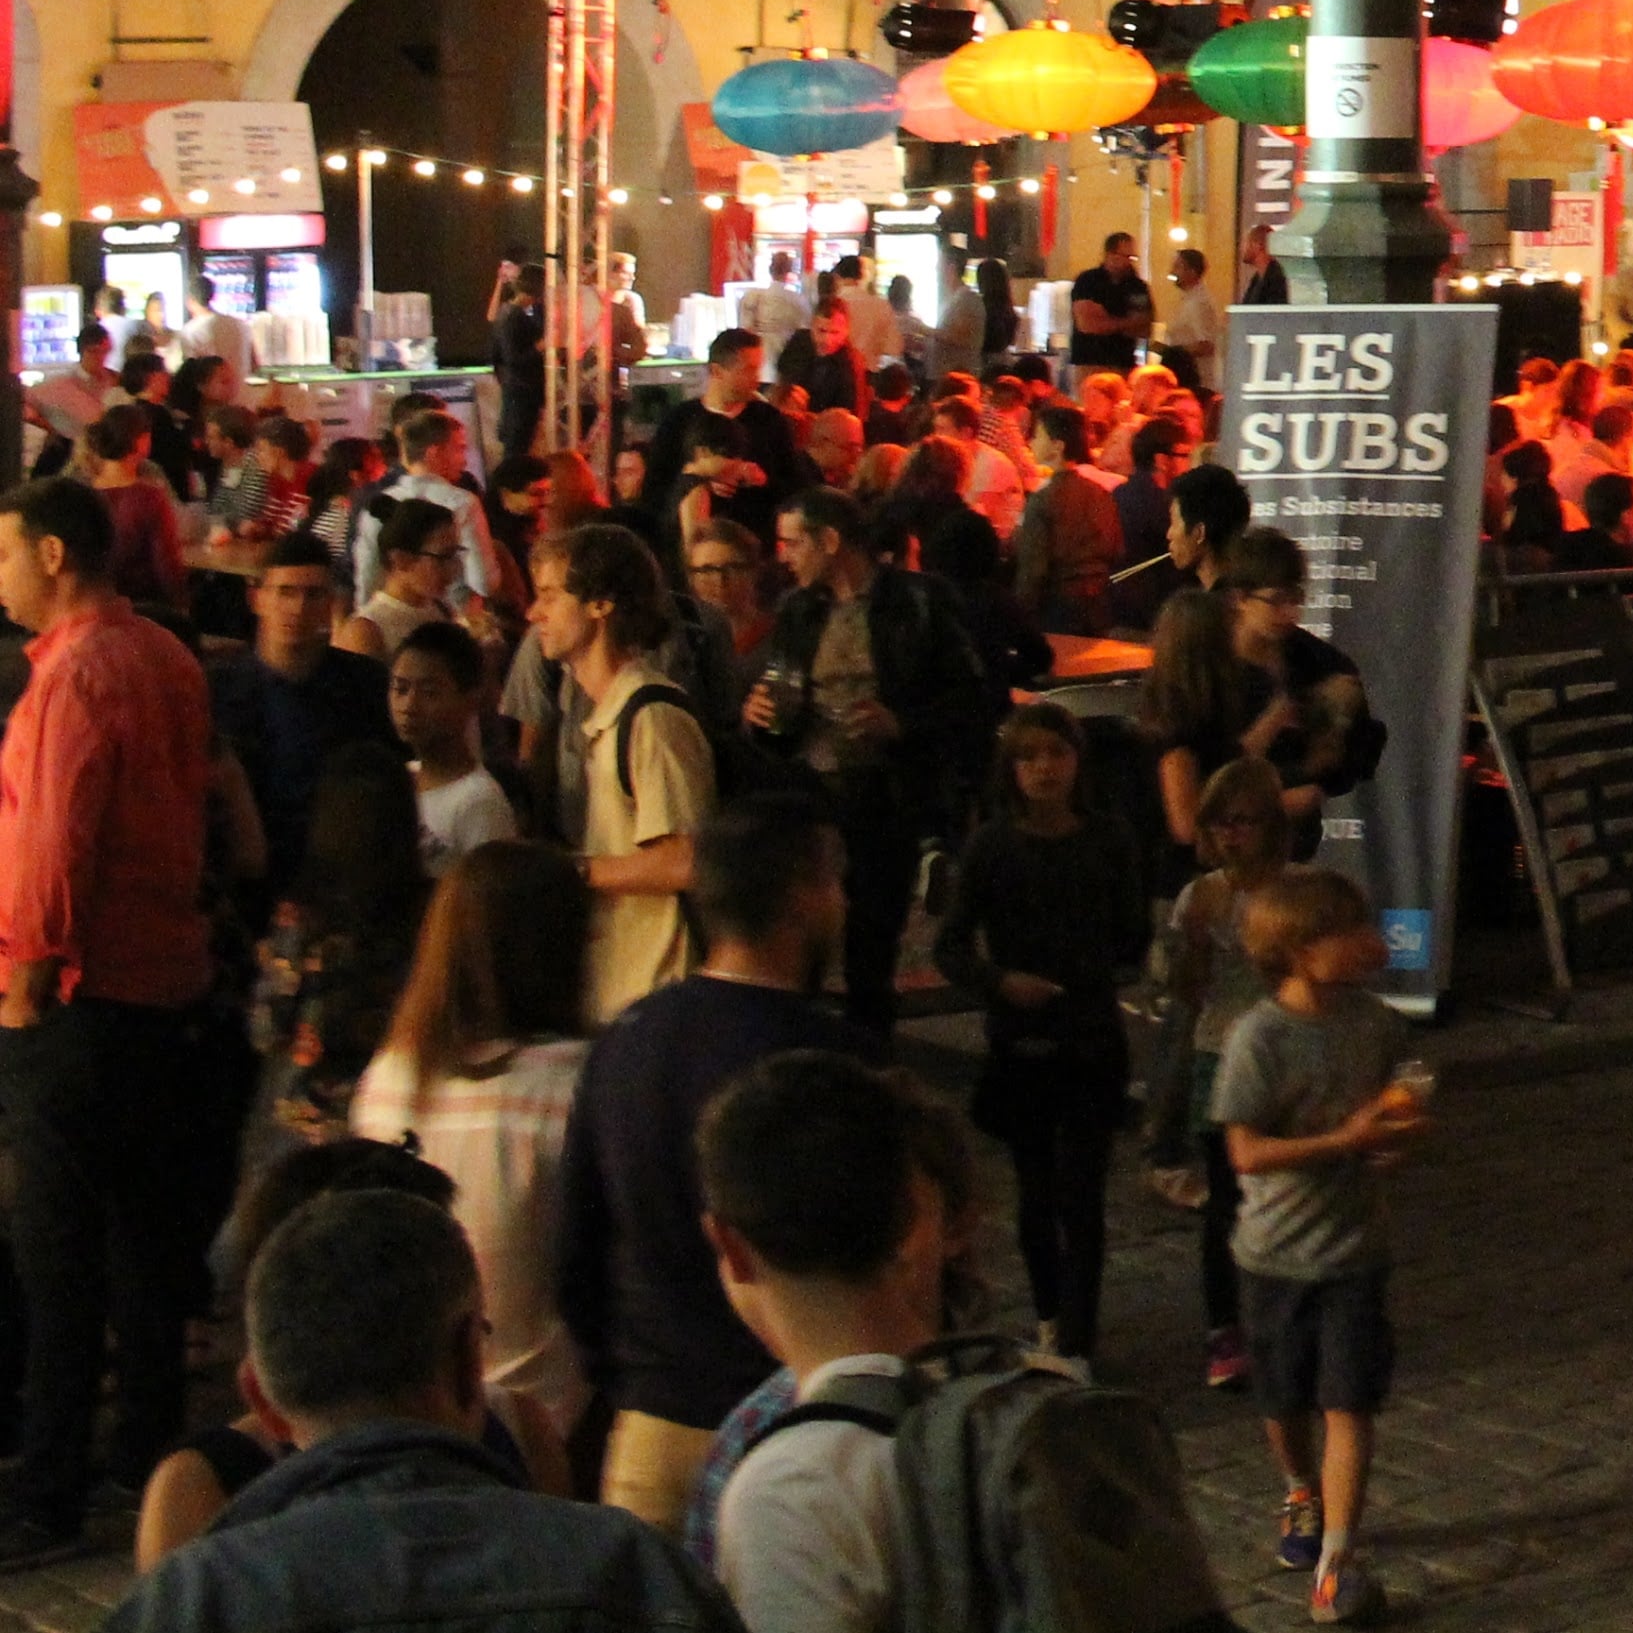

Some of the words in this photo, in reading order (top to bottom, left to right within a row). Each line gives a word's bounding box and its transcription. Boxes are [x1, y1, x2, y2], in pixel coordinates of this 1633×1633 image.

[1241, 332, 1394, 393] LES
[1237, 411, 1449, 473] SUBS
[1250, 502, 1277, 517] es
[1281, 496, 1443, 518] Subsistances
